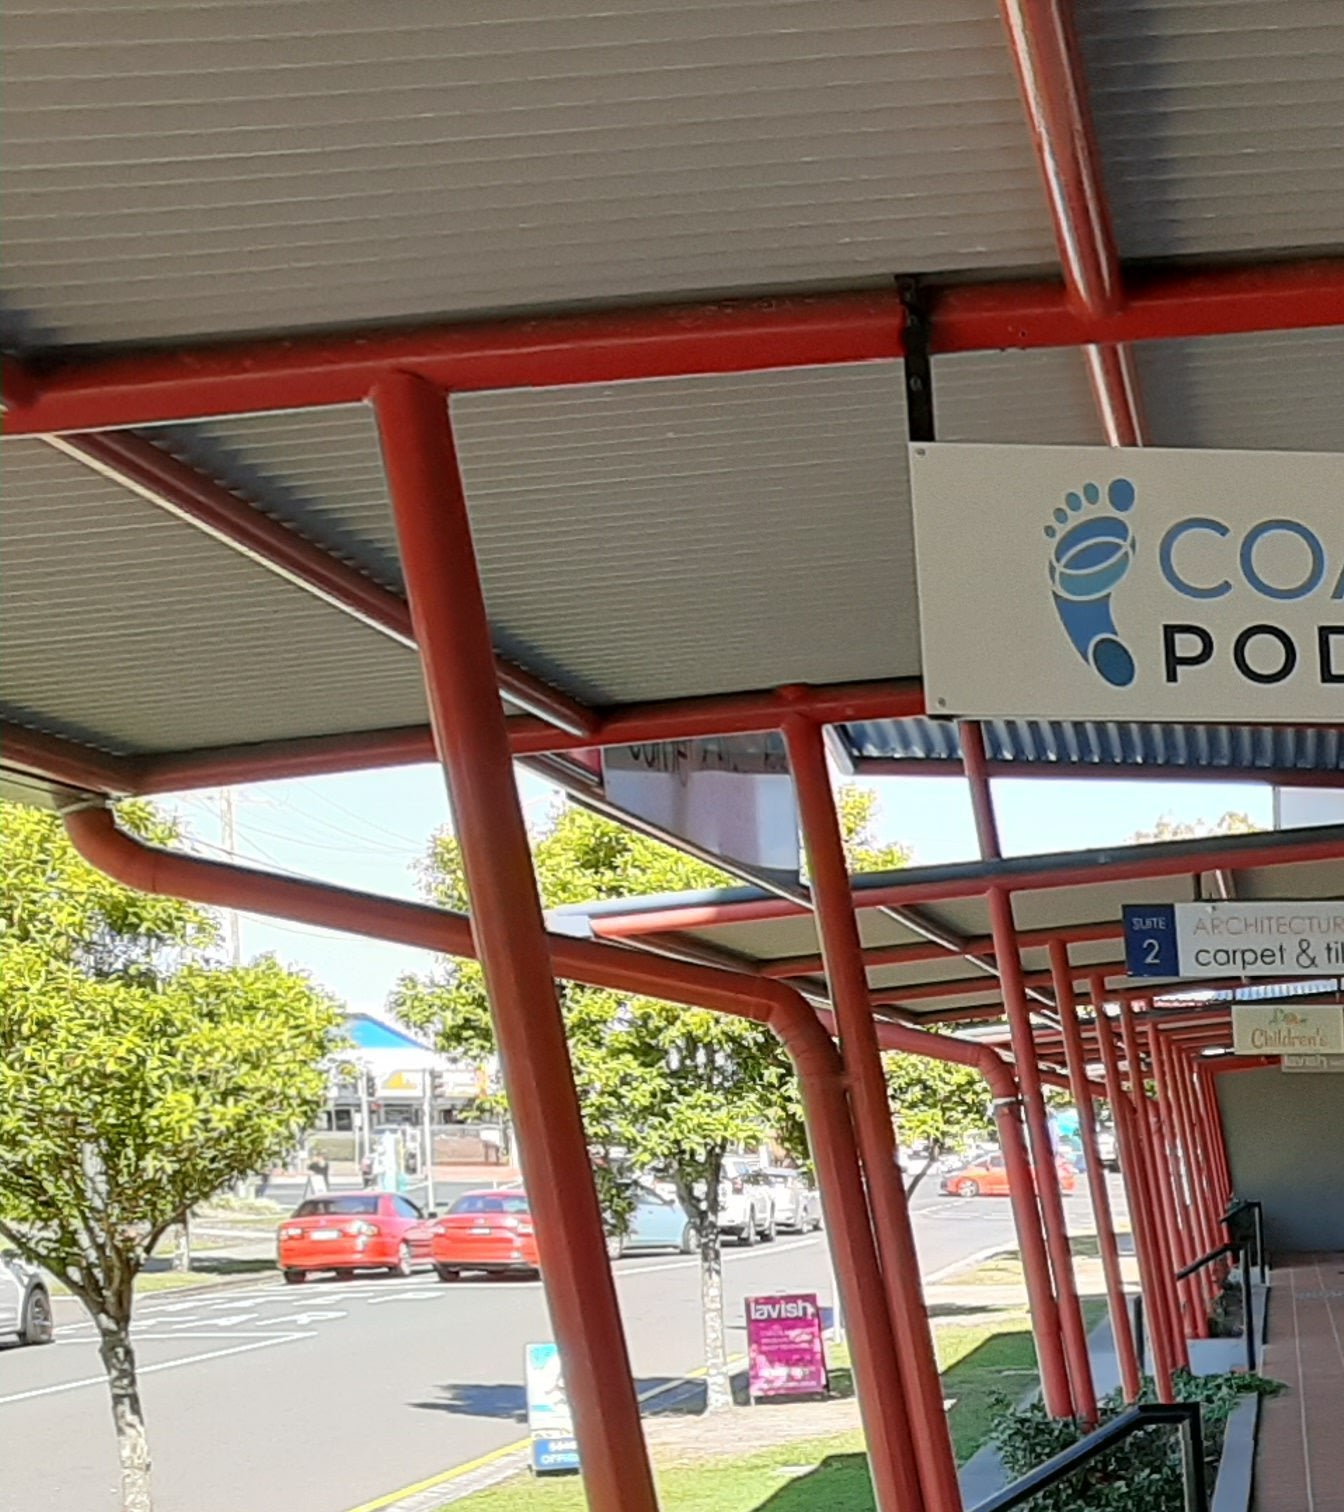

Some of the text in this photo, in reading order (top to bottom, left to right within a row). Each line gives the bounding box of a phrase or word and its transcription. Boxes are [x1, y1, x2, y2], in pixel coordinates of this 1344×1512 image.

[1130, 916, 1166, 931] SUITE
[1142, 938, 1161, 965] 2
[1194, 942, 1285, 970] carpet
[1295, 938, 1318, 969] &
[1251, 1028, 1329, 1049] Children's
[751, 1299, 813, 1320] lavish
